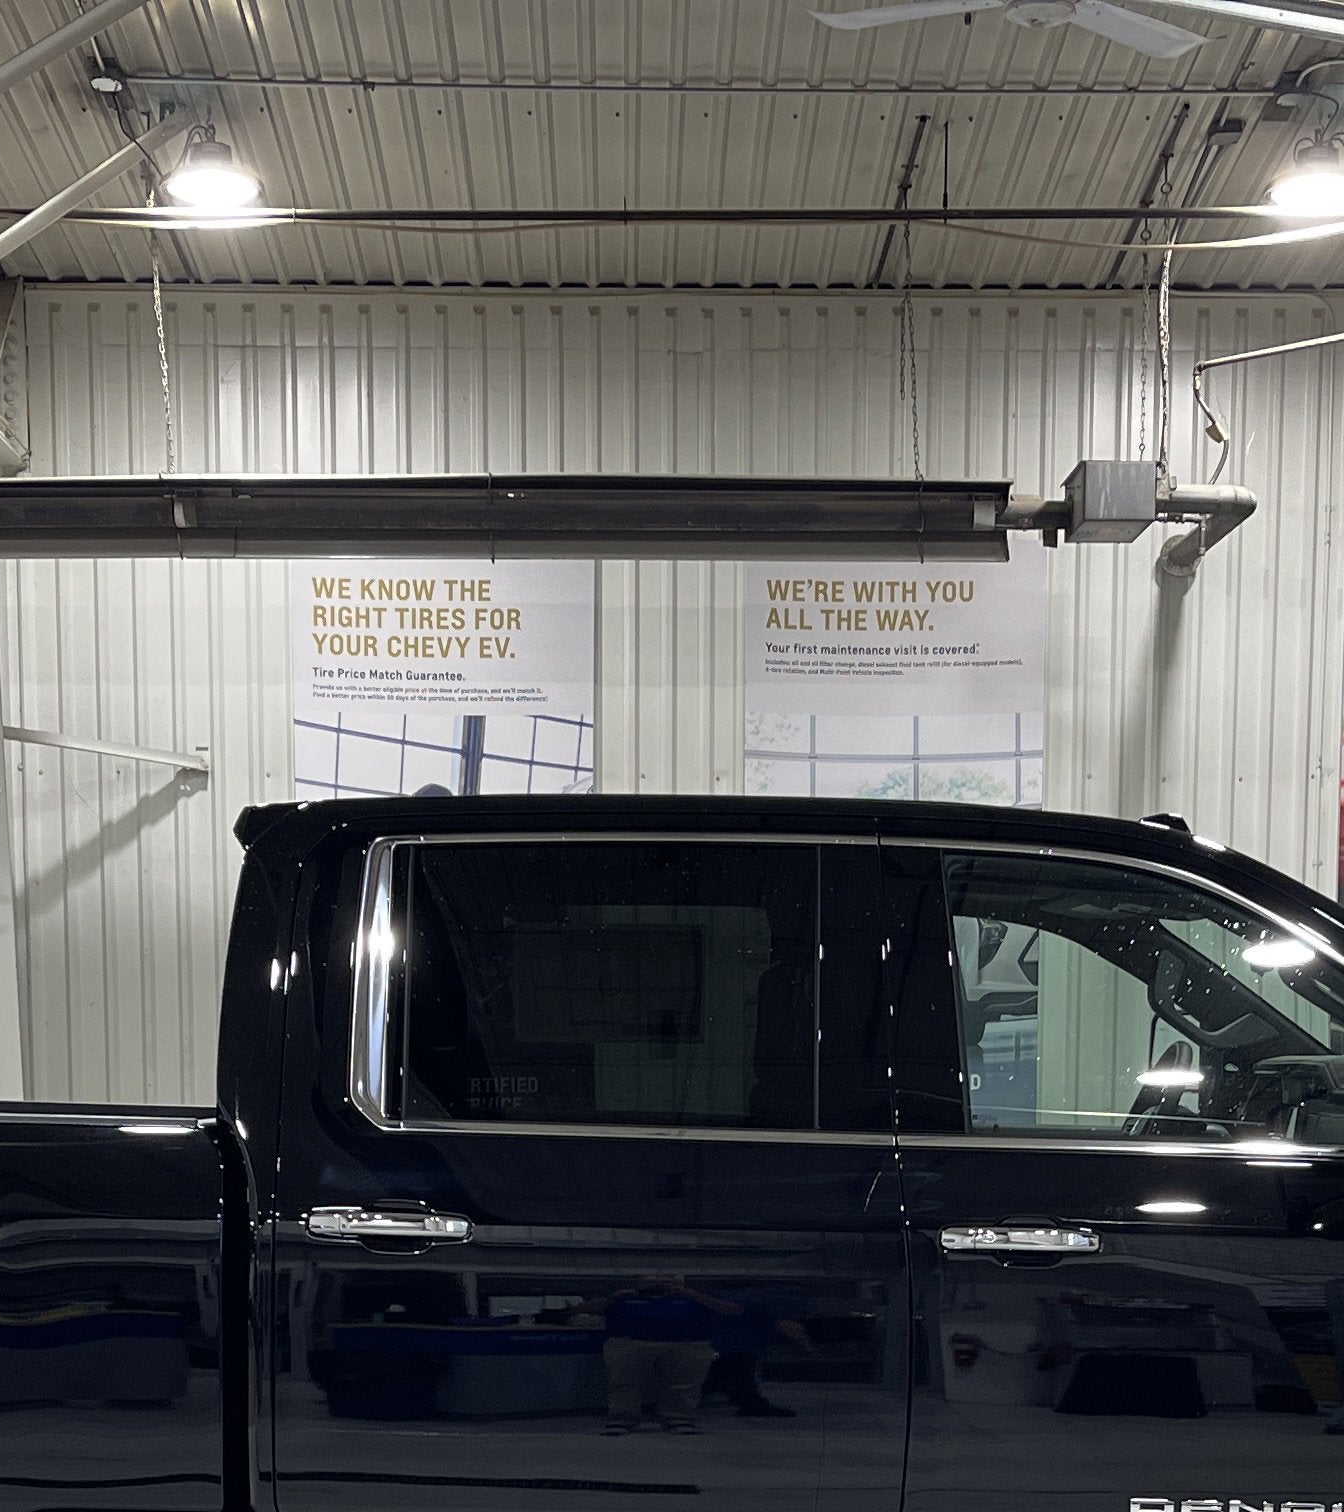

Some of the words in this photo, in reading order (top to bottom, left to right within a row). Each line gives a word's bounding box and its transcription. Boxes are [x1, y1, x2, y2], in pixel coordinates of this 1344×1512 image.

[312, 577, 351, 599] WE
[360, 578, 436, 601] KNOW
[444, 580, 491, 602] THE
[767, 579, 845, 602] WE'RE
[854, 581, 917, 603] WITH
[926, 581, 975, 603] YOU
[313, 606, 386, 629] RIGHT
[395, 608, 465, 630] TIRES
[474, 608, 521, 630] FOR
[766, 608, 813, 630] ALL
[820, 609, 868, 631] THE
[876, 609, 934, 632] WAY.
[312, 633, 377, 657] YOUR
[387, 636, 470, 658] CHEVY
[479, 637, 516, 658] EV.
[765, 642, 790, 654] Your
[793, 643, 817, 655] first
[821, 644, 891, 656] maintenance
[894, 645, 917, 655] visit
[920, 645, 929, 655] is
[313, 667, 334, 678] Tire
[338, 668, 366, 679] Price
[369, 669, 402, 680] Match
[406, 670, 466, 681] Guarantee.
